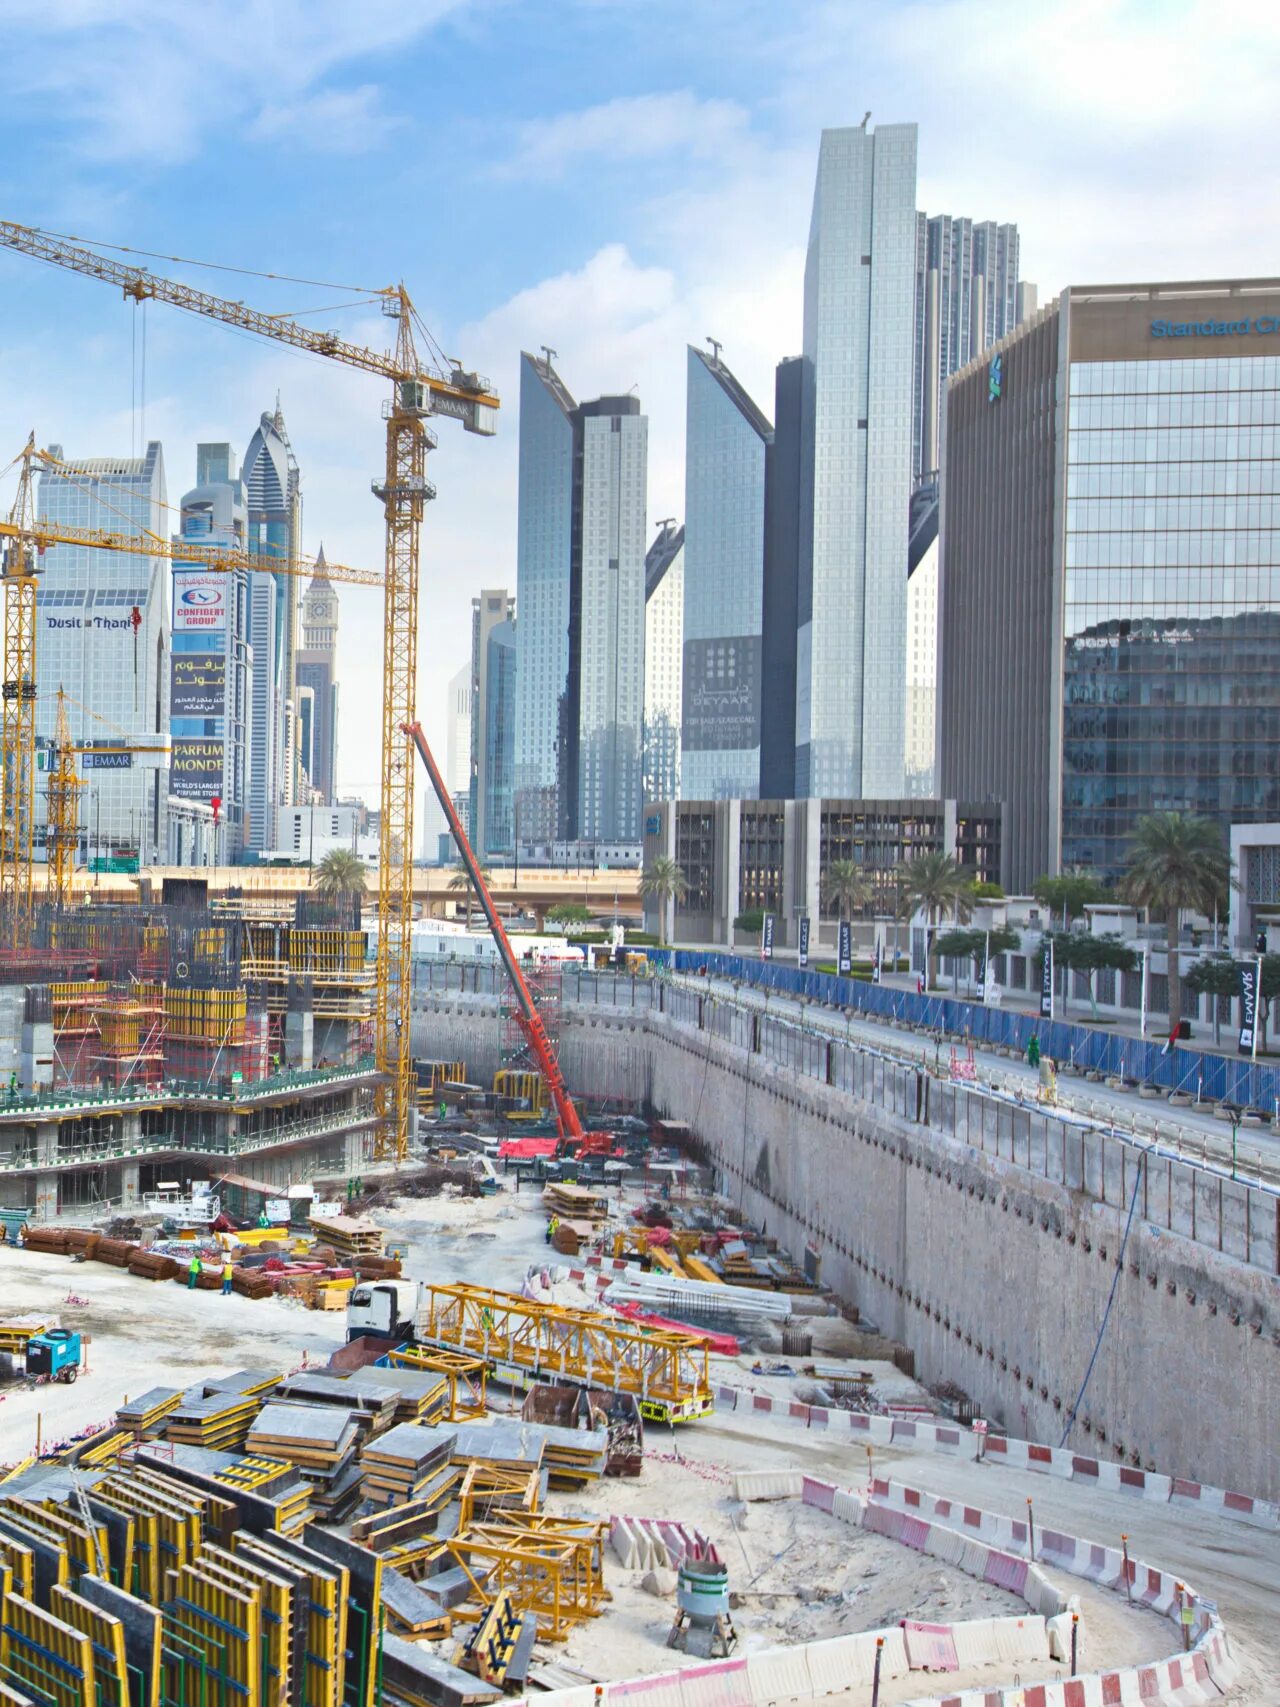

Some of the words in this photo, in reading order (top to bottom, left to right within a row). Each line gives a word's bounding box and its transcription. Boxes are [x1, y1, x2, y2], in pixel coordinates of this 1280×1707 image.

[1151, 316, 1250, 337] Standard
[177, 608, 225, 616] CONFIDENT
[46, 616, 82, 629] Dusit
[93, 616, 131, 630] Thani
[186, 617, 217, 625] GROUP
[694, 697, 749, 705] DEYAAR
[174, 745, 224, 756] PARFUM
[94, 755, 129, 766] EMAAR
[174, 760, 224, 771] MONDE
